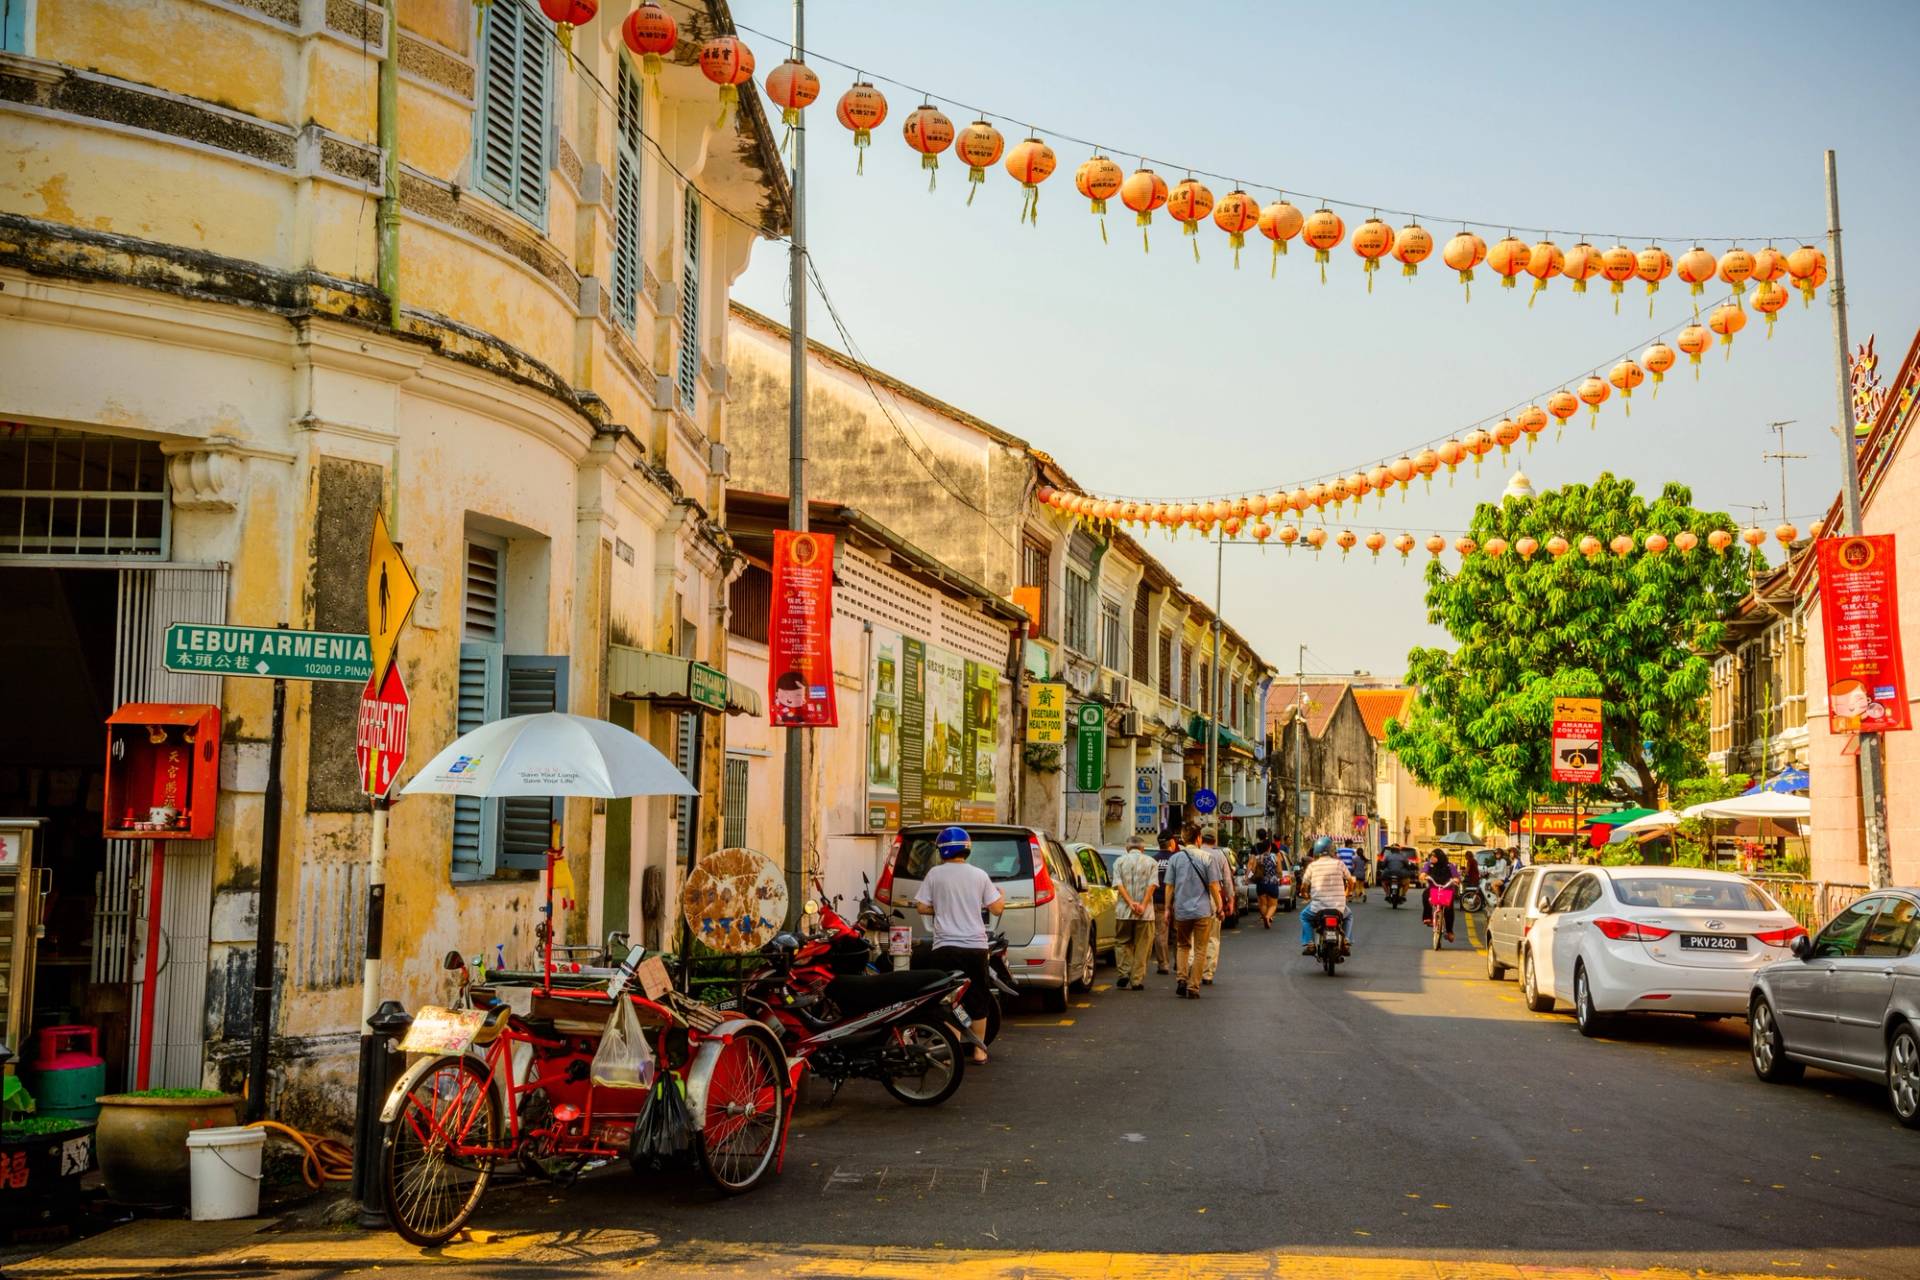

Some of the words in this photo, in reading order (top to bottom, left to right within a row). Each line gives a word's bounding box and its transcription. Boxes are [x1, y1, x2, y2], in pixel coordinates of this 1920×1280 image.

[645, 12, 662, 20] 2014
[933, 117, 948, 125] 2014
[176, 629, 255, 655] LEBUH
[260, 634, 372, 661] ARMENIA
[176, 652, 250, 670] 本頭公巷
[304, 663, 331, 675] 10200
[334, 665, 341, 675] P.
[344, 666, 374, 677] PINAN
[1031, 709, 1060, 718] VEGETARIAN
[1029, 721, 1047, 730] HEALTH
[1048, 721, 1061, 730] FOOD
[1038, 731, 1050, 740] CAFE
[1690, 936, 1709, 947] PKV
[1711, 937, 1737, 949] 2420
[0, 1151, 30, 1189] 福
